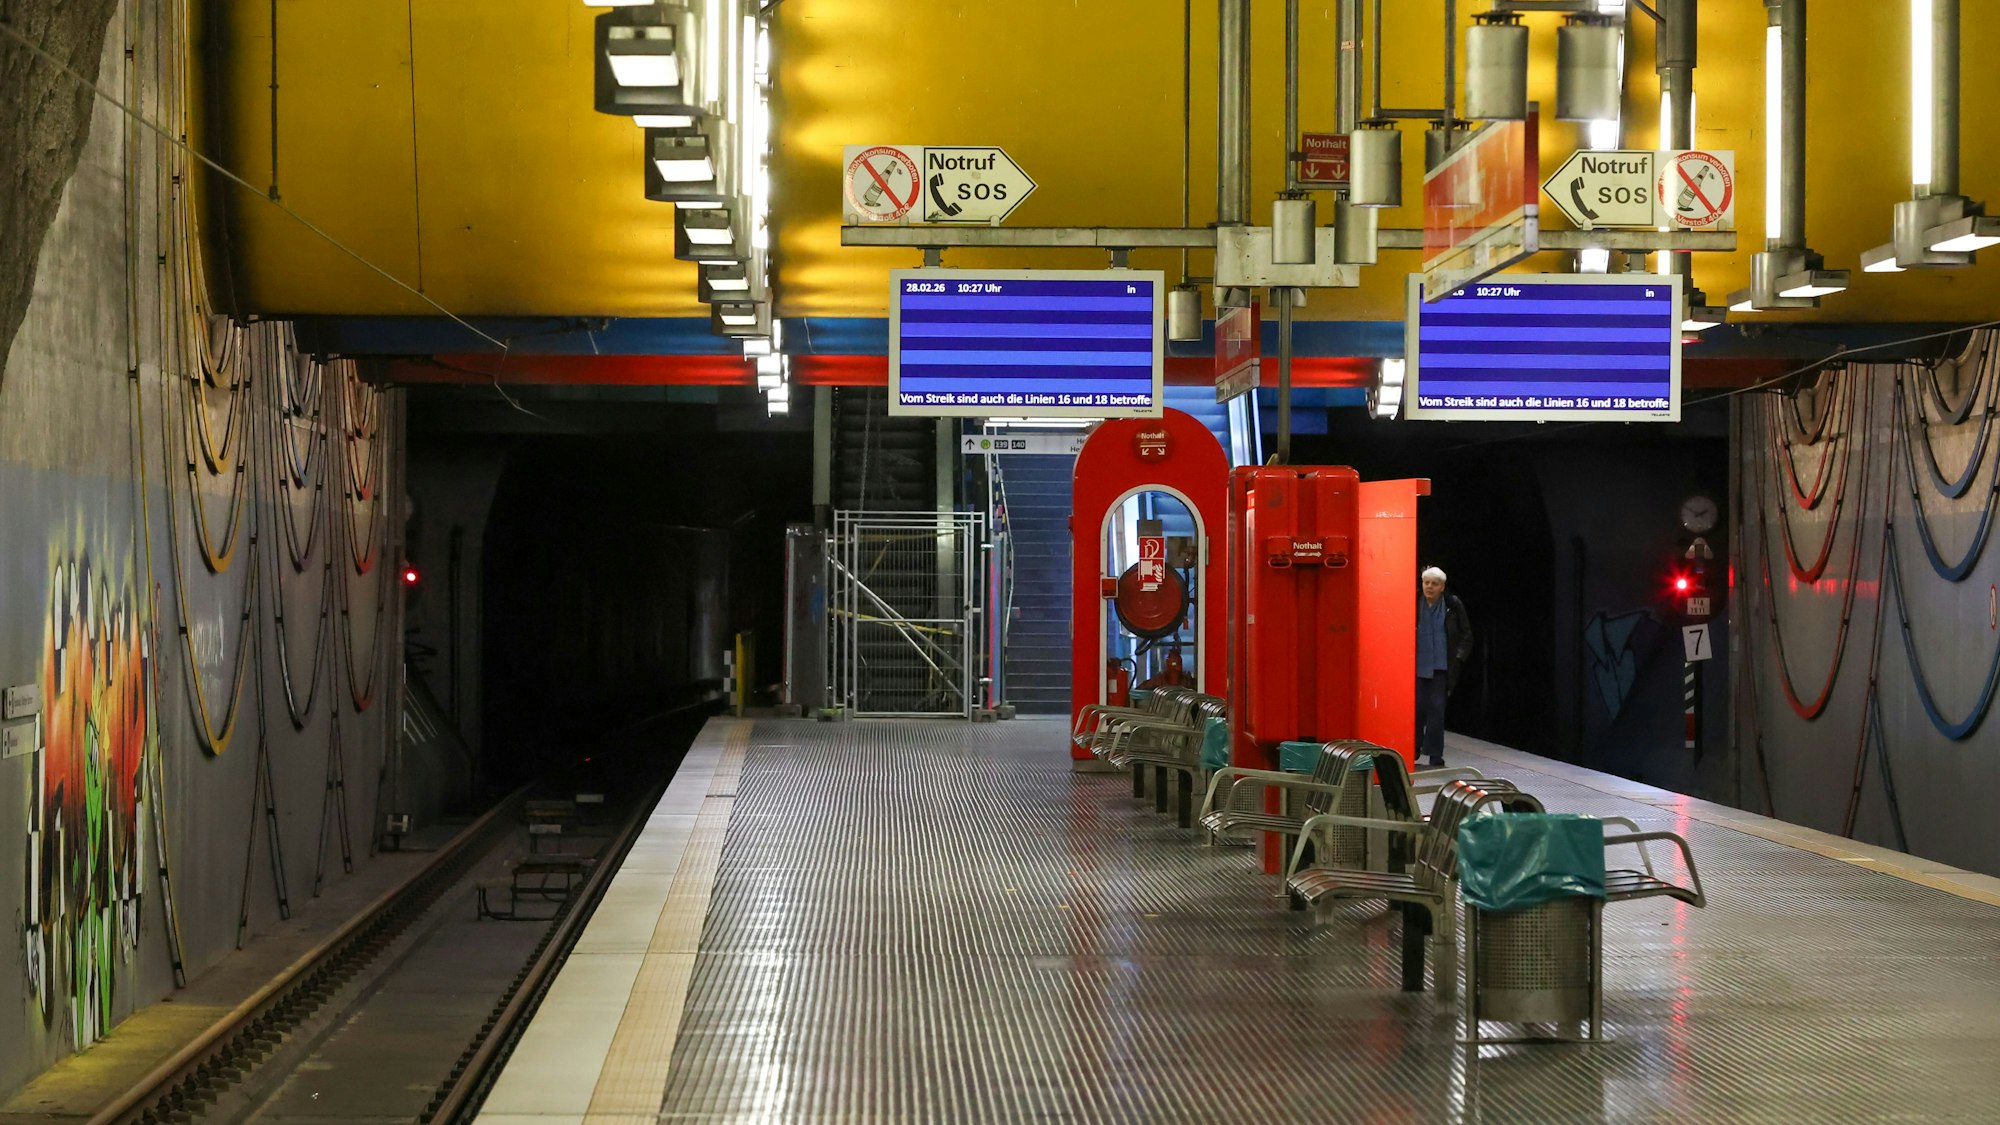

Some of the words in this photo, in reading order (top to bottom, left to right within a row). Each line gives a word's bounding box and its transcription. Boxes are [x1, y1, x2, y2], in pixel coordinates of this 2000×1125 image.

[1306, 138, 1347, 149] Nothalt
[896, 152, 919, 182] verboten
[929, 153, 996, 171] Notruf
[1581, 156, 1648, 174] Notruf
[1709, 158, 1731, 187] verboten
[957, 183, 1007, 201] SOS
[1598, 186, 1648, 204] SOS
[1676, 213, 1708, 227] Verstoß
[906, 283, 946, 293] 28.02.26
[957, 283, 983, 293] 10:27
[984, 283, 1003, 293] Uhr
[1126, 284, 1136, 294] in
[1476, 287, 1502, 297] 10:27
[1503, 287, 1522, 297] Uhr
[1645, 288, 1655, 297] in
[900, 393, 924, 404] Vom
[925, 393, 956, 404] Streik
[956, 393, 979, 404] sind
[980, 393, 1005, 404] auch
[1006, 394, 1023, 404] die
[1024, 394, 1055, 405] Linien
[1057, 394, 1071, 405] 16
[1072, 394, 1093, 405] und
[1095, 395, 1108, 405] 18
[1419, 397, 1443, 407] Vom
[1444, 396, 1475, 407] Streik
[1475, 396, 1498, 407] sind
[1498, 397, 1524, 407] auch
[1525, 397, 1542, 407] die
[1543, 397, 1574, 408] Linien
[1576, 398, 1589, 408] 16
[1591, 398, 1611, 408] und
[1613, 398, 1626, 408] 18
[1628, 398, 1669, 409] betroffe
[1012, 440, 1025, 449] 140
[1293, 541, 1322, 549] Nothalt
[1690, 630, 1703, 655] 7
